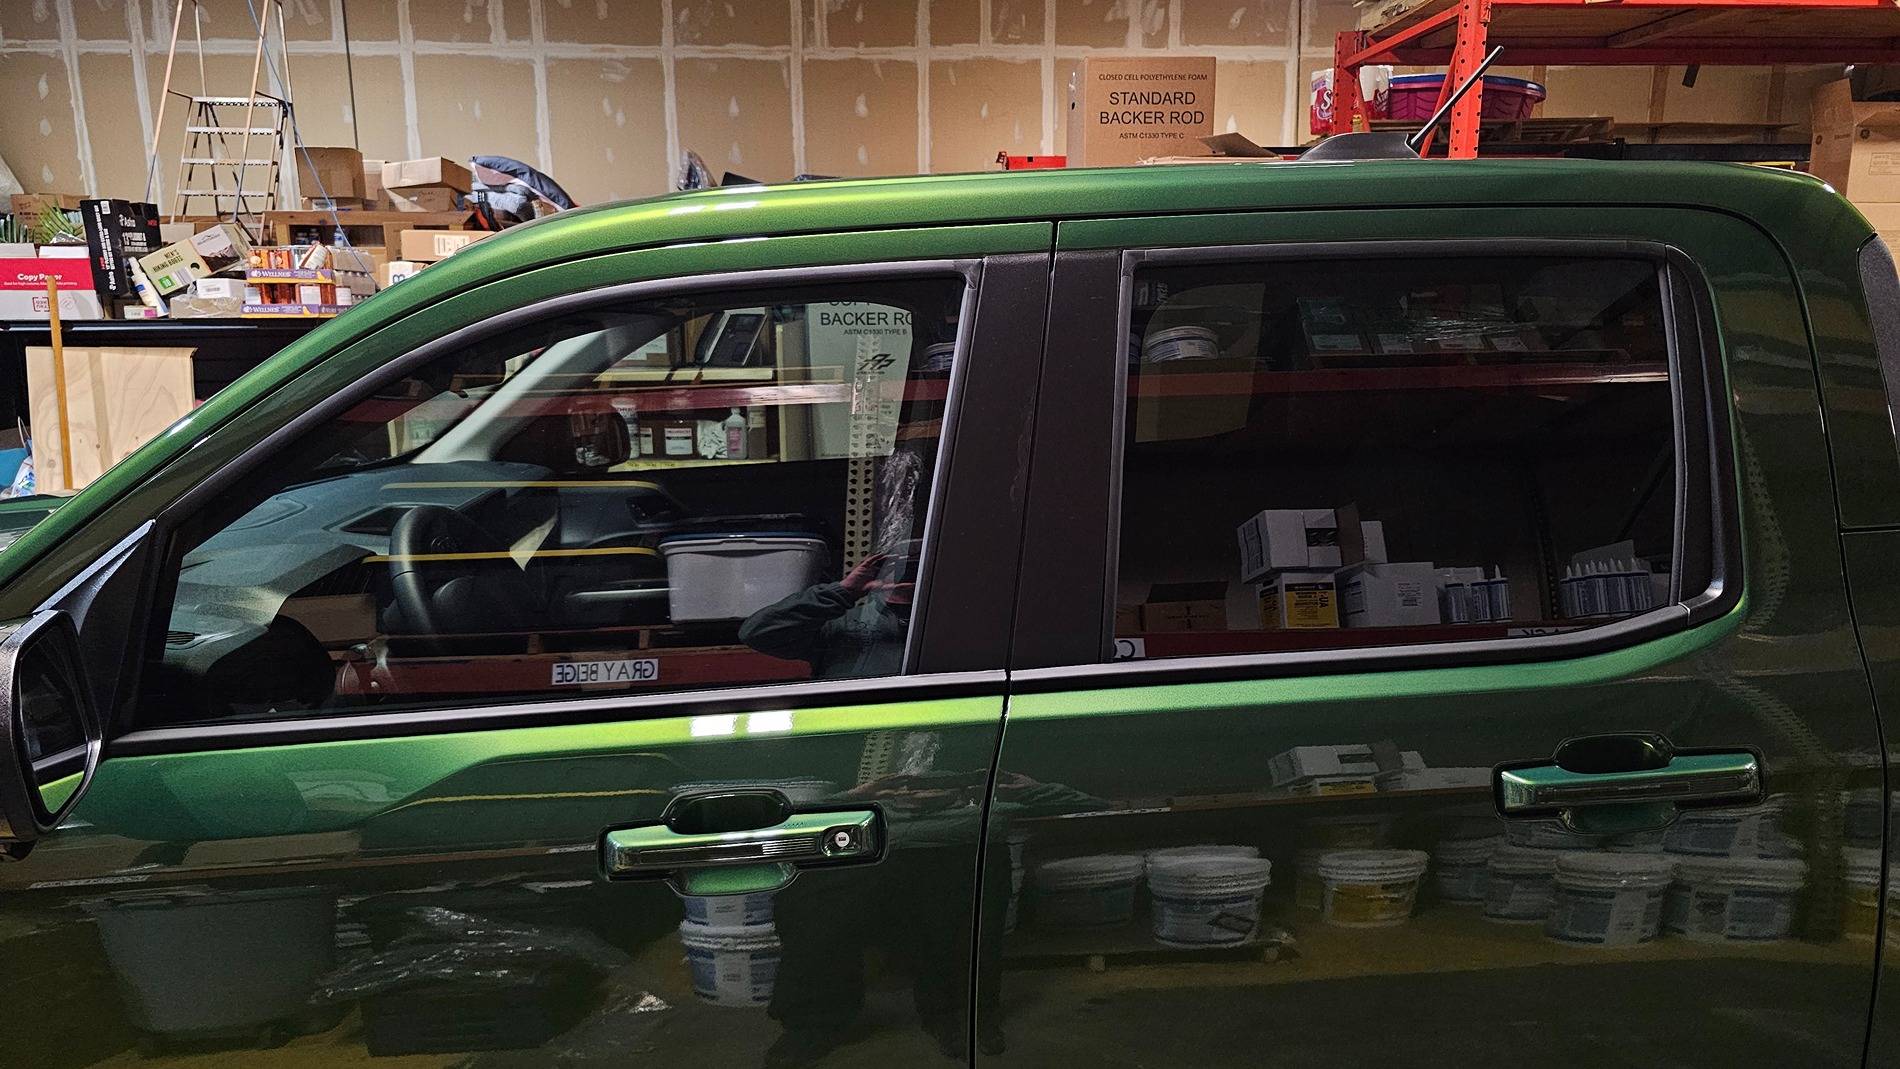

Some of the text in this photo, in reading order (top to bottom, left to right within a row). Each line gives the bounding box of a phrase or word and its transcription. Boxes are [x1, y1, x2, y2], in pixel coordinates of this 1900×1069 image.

[1109, 91, 1196, 105] STANDARD
[1100, 111, 1205, 125] BACKER ROD
[153, 255, 184, 273] HIKING BOOTS
[17, 273, 38, 281] Copy
[820, 312, 889, 326] BACKER
